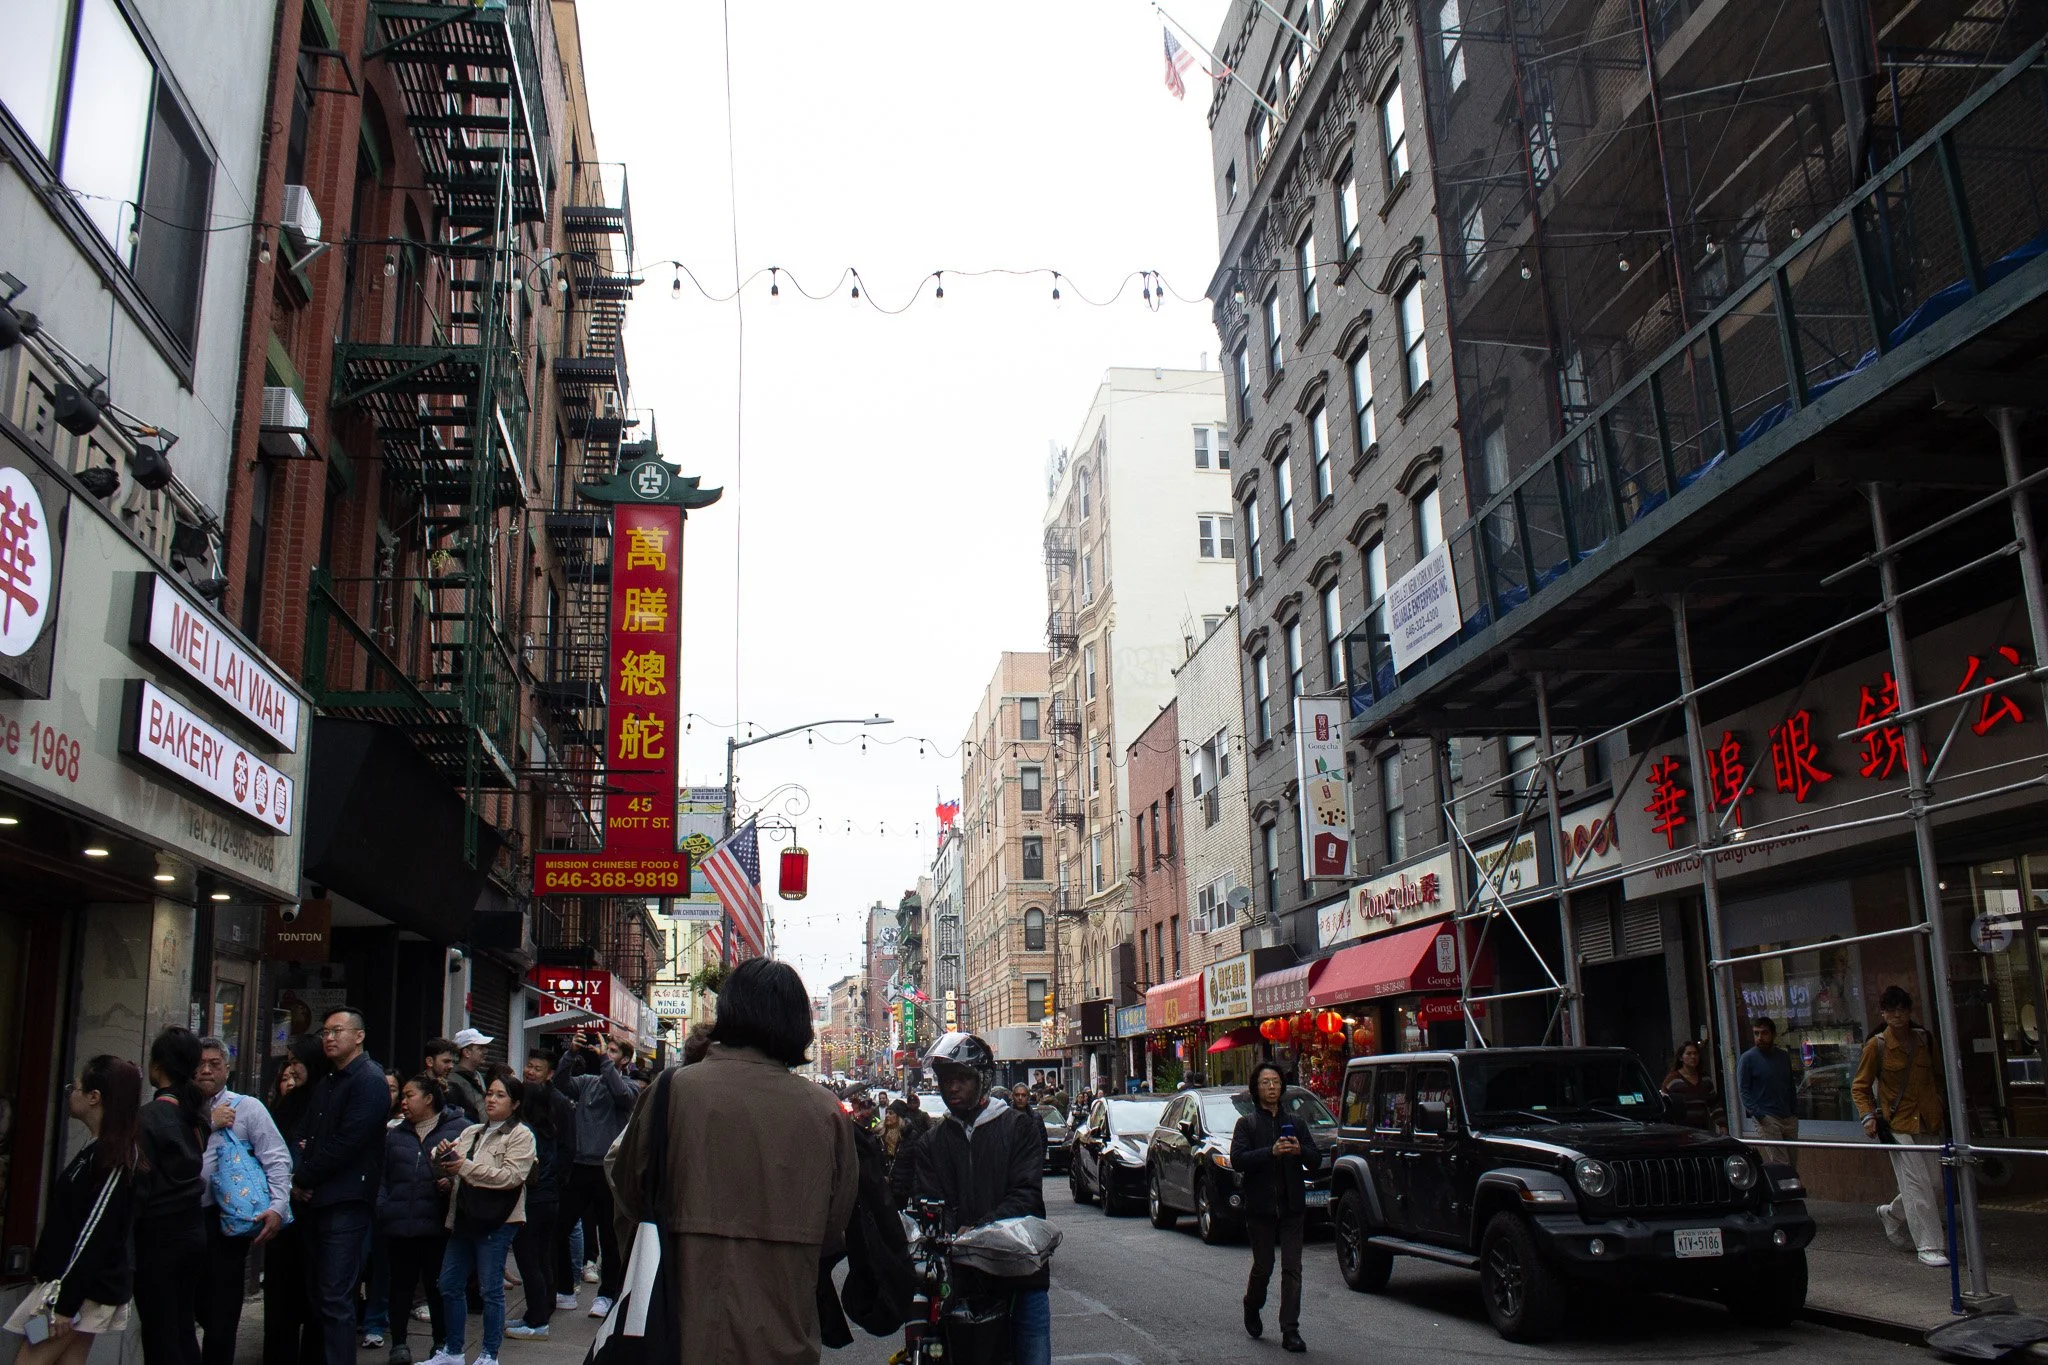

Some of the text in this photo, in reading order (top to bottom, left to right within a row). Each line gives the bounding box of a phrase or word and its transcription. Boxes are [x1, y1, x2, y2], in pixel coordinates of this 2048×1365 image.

[618, 526, 669, 761] 萬膳總舵
[170, 602, 285, 735] MEI LAI WAH
[149, 698, 224, 780] BAKERY
[1308, 743, 1326, 751] Gong
[30, 719, 80, 783] 1968
[628, 797, 652, 812] 45
[610, 817, 670, 829] MOTT ST.
[210, 820, 274, 873] 212-966-7866
[546, 860, 679, 869] MISSION CHINESE FOOD 6
[546, 872, 678, 888] 646-368-9819
[1358, 886, 1393, 924] Gong
[1394, 873, 1418, 910] cha
[277, 932, 322, 942] TONTON
[548, 979, 602, 995] I NY
[1427, 976, 1463, 987] Gong ch
[583, 997, 593, 1013] &
[655, 1007, 687, 1015] LIQUOR
[1266, 1005, 1274, 1014] RED
[1274, 1003, 1285, 1013] APPLE
[1286, 1001, 1294, 1011] GIFT
[1294, 999, 1304, 1010] SHOP
[1426, 1003, 1465, 1014] Gong ch
[1678, 1235, 1720, 1251] KTV 5186
